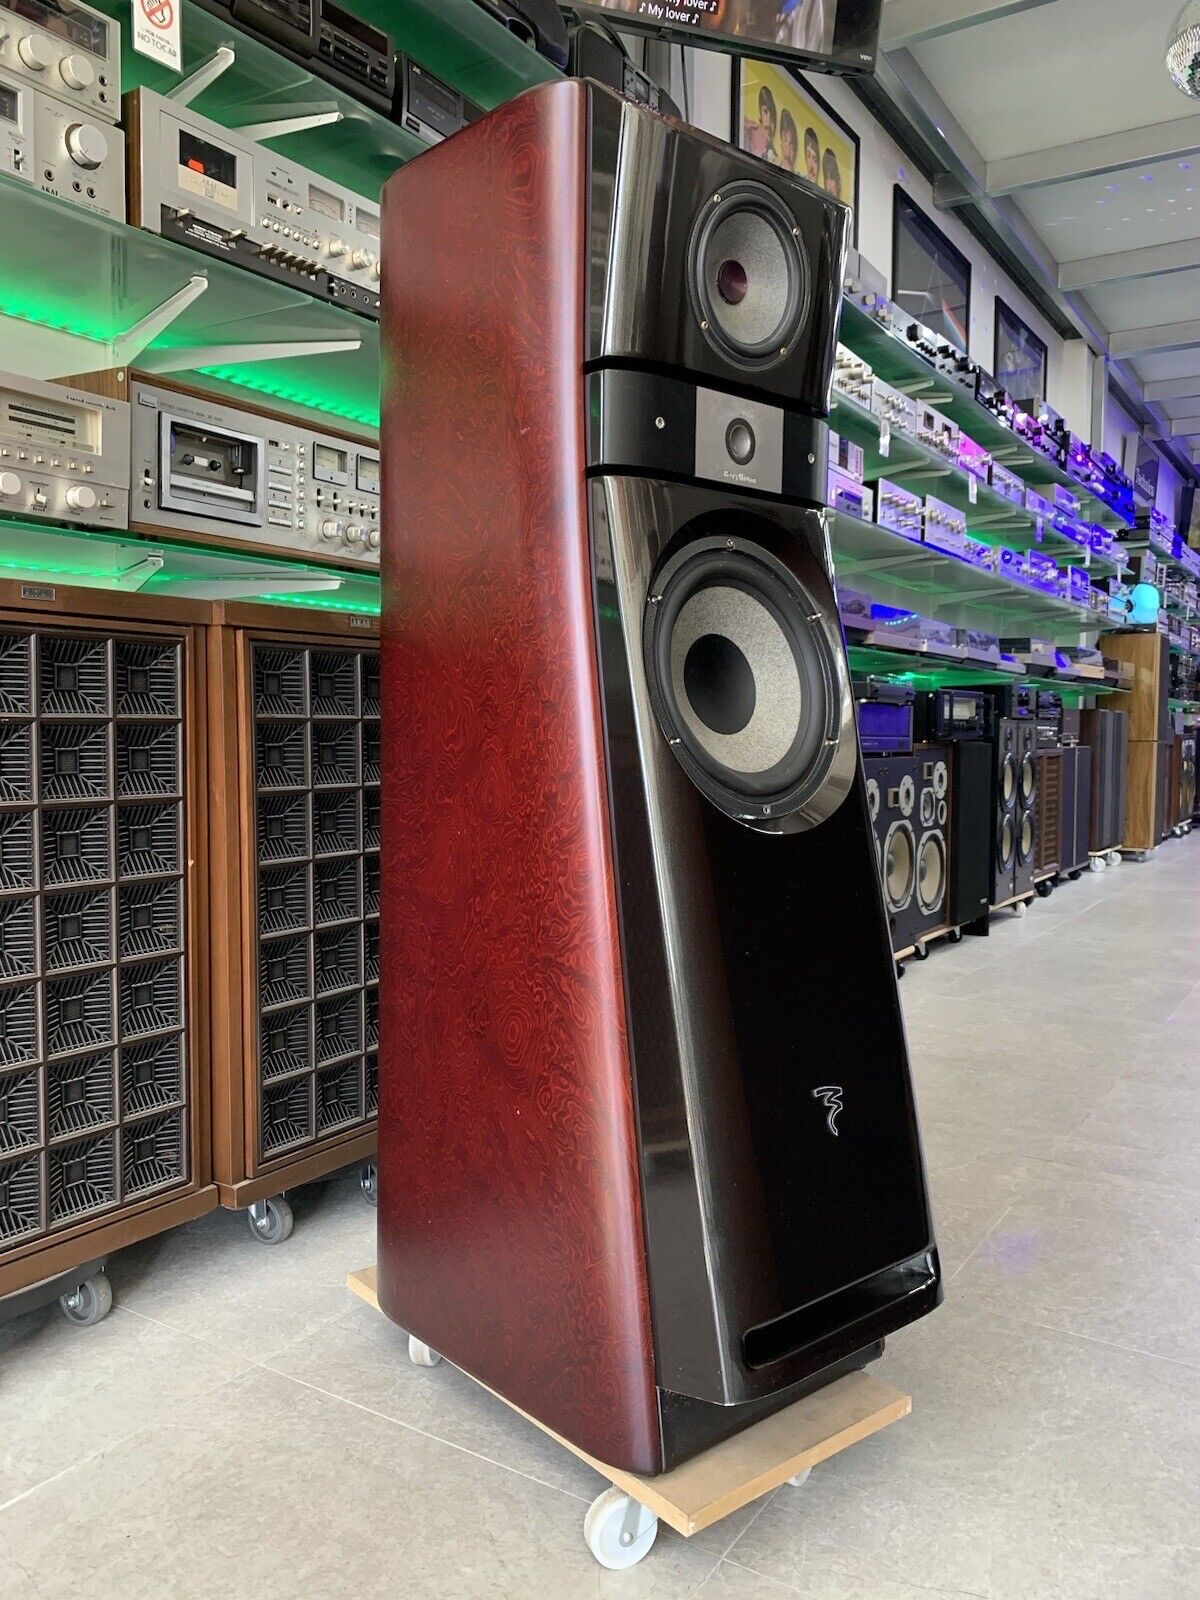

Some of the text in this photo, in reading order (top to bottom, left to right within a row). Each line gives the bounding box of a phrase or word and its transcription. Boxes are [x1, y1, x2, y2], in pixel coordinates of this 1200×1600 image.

[683, 0, 708, 10] lover
[648, 3, 691, 22] My lover
[137, 31, 151, 44] NO
[41, 185, 58, 196] AKAI
